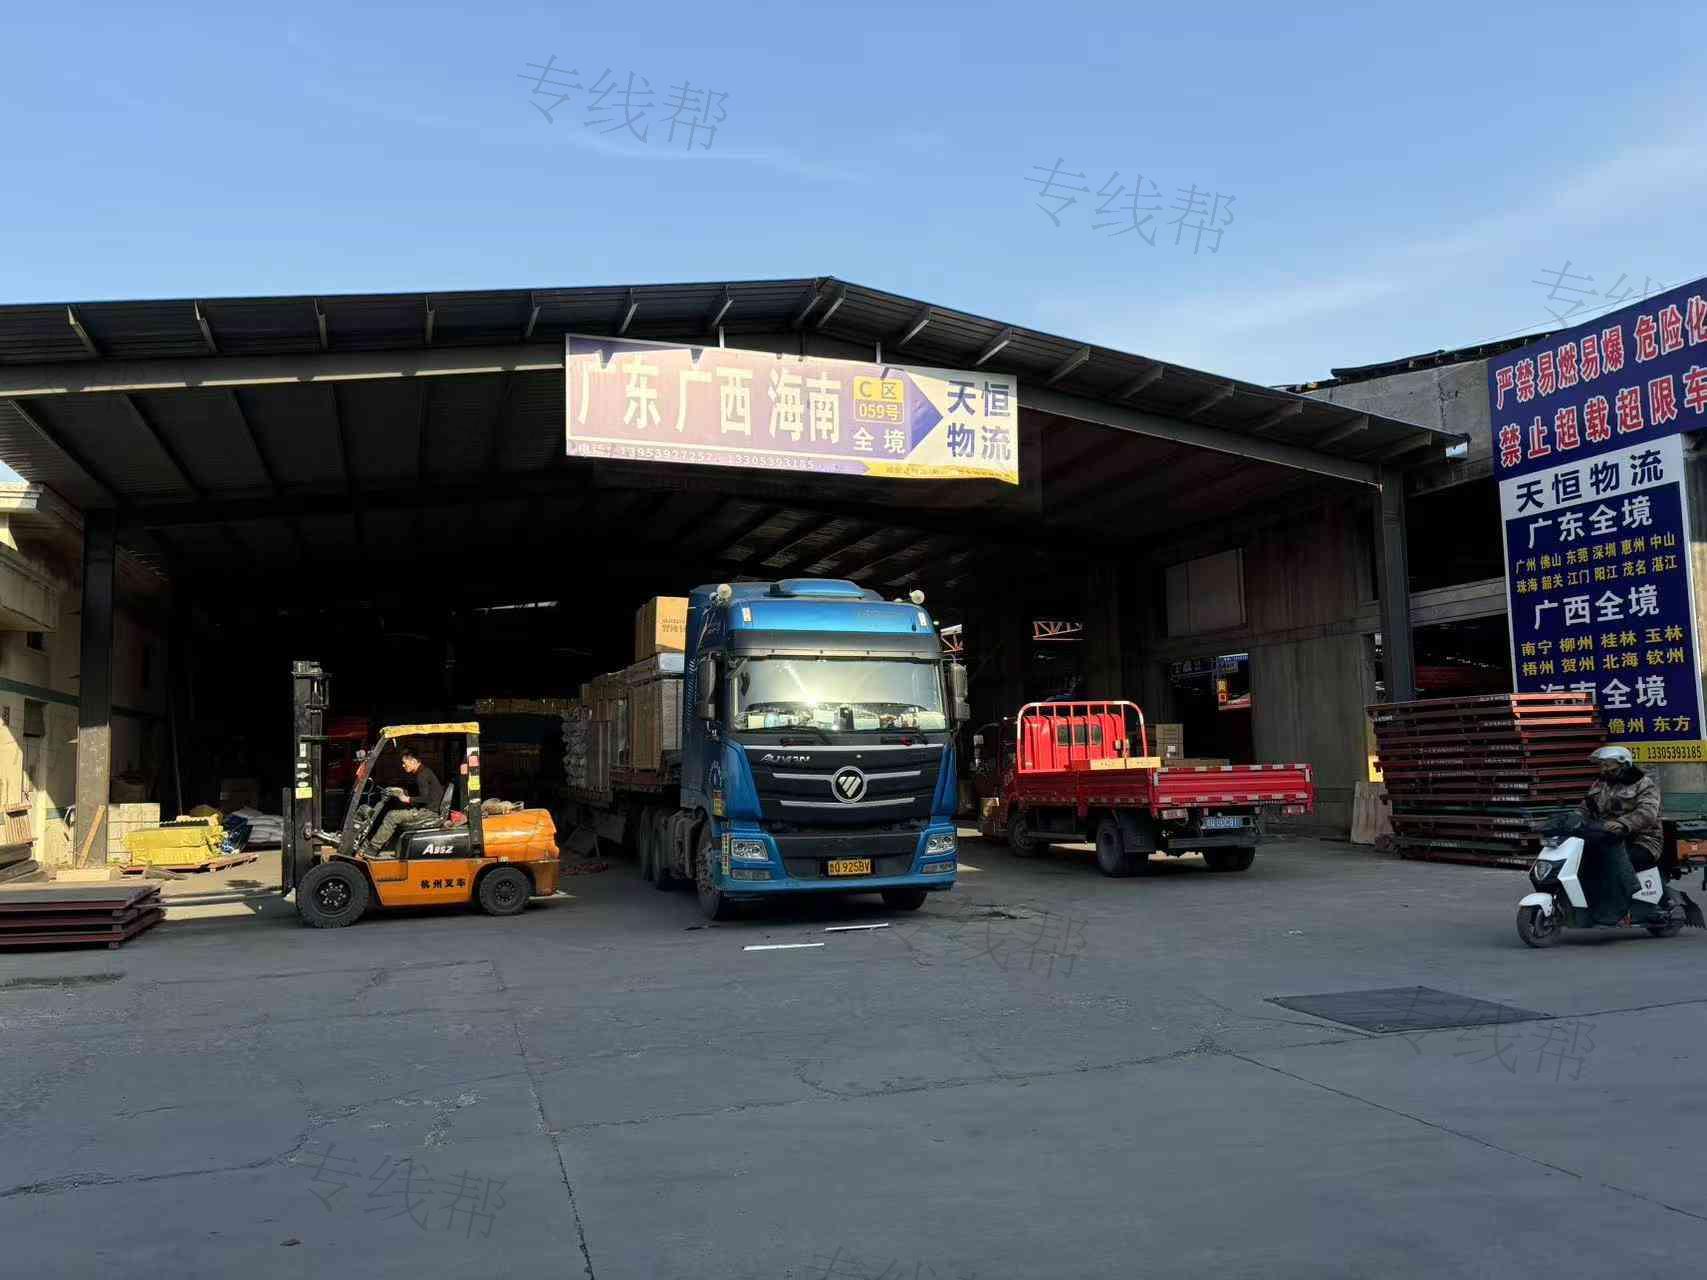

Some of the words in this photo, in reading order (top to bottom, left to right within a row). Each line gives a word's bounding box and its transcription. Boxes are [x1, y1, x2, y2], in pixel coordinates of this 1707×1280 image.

[1495, 325, 1624, 409] 严禁易燃易爆
[1634, 295, 1707, 362] 危险化
[859, 403, 899, 421] 059号
[947, 380, 1010, 417] 天恒
[1500, 365, 1707, 467] 禁止超载超限车
[852, 427, 906, 454] 全境
[947, 422, 1010, 461] 物流
[1516, 449, 1664, 512] 天恒物流
[1528, 495, 1653, 549] 广东全境
[1650, 531, 1675, 549] 中山
[1534, 583, 1660, 630] 广西全境
[1521, 639, 1552, 656] 南宁
[1559, 635, 1593, 652] 柳州
[1600, 630, 1637, 648] 桂林
[1645, 624, 1683, 643] 玉林
[1602, 651, 1639, 671] 北海
[1608, 717, 1645, 734] 儋州
[1653, 715, 1691, 733] 东方
